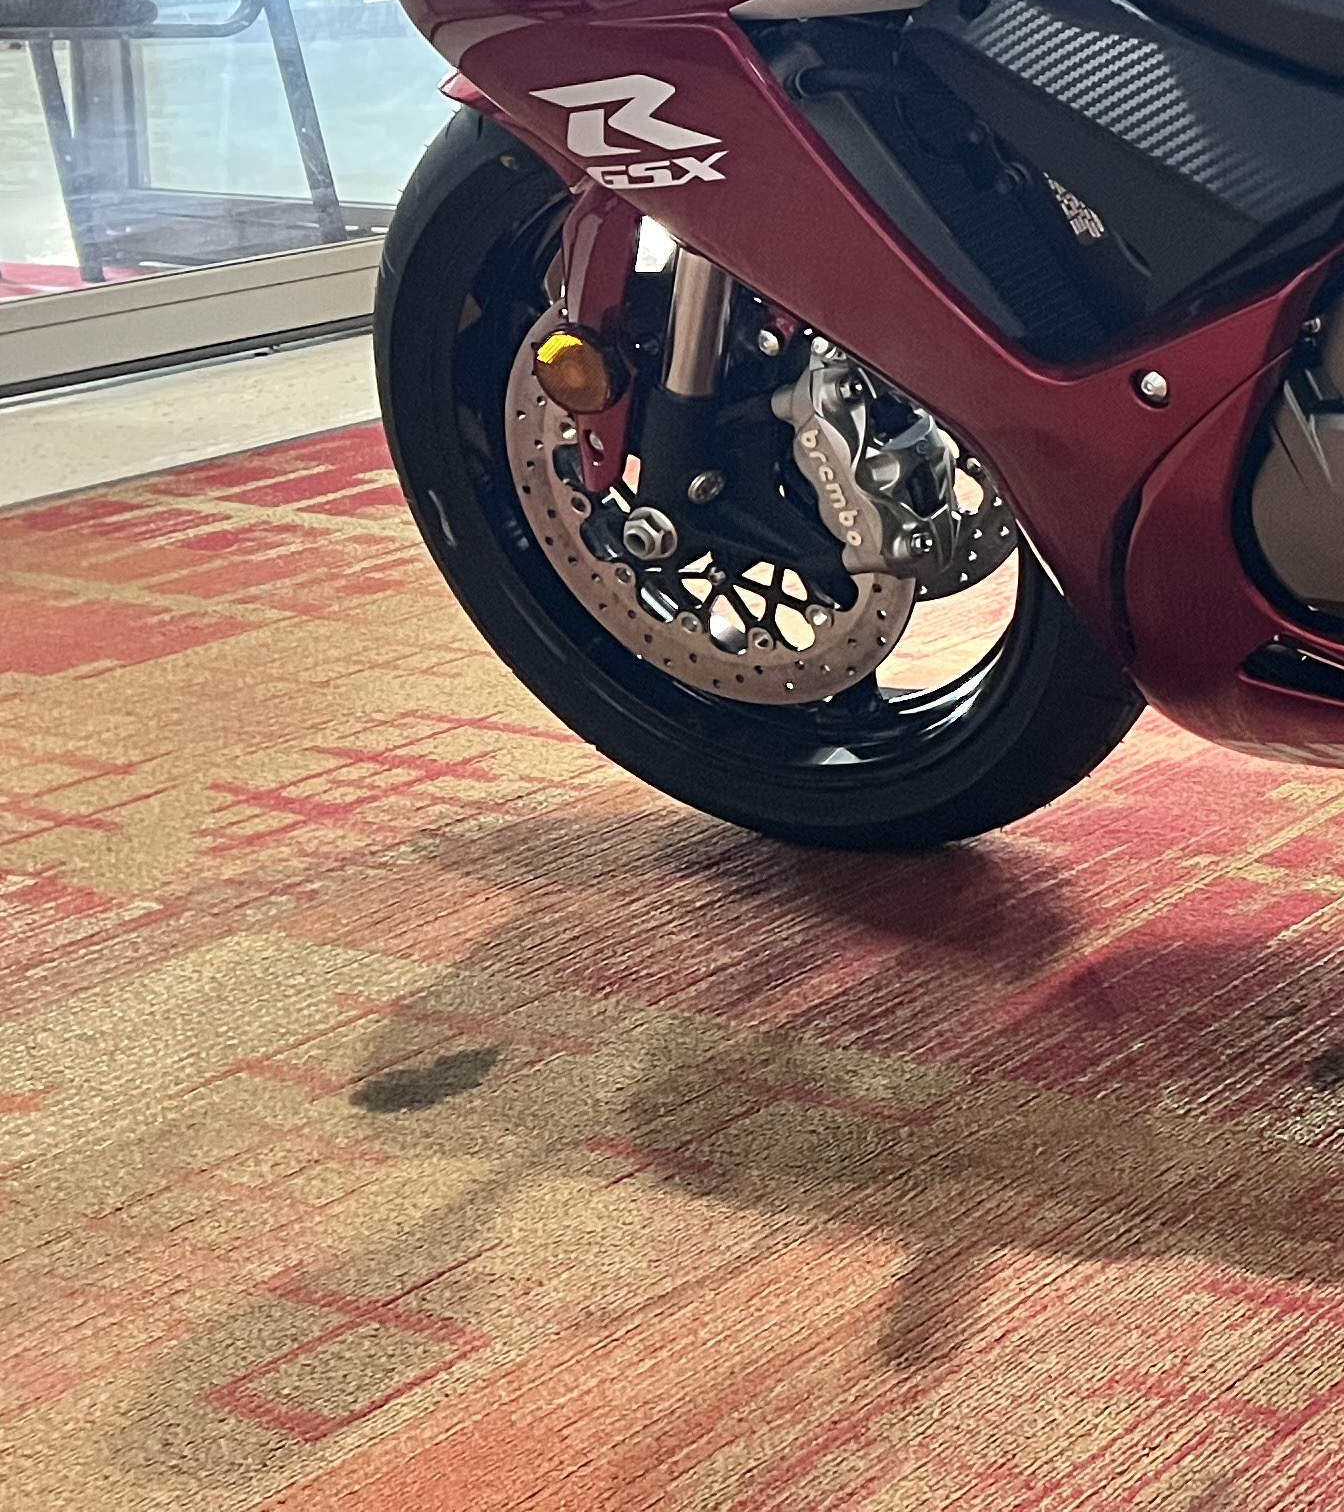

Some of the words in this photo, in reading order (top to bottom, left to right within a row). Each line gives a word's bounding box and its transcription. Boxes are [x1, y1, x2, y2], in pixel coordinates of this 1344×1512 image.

[528, 73, 722, 158] R
[586, 150, 729, 190] GSX
[801, 428, 862, 547] brembo
